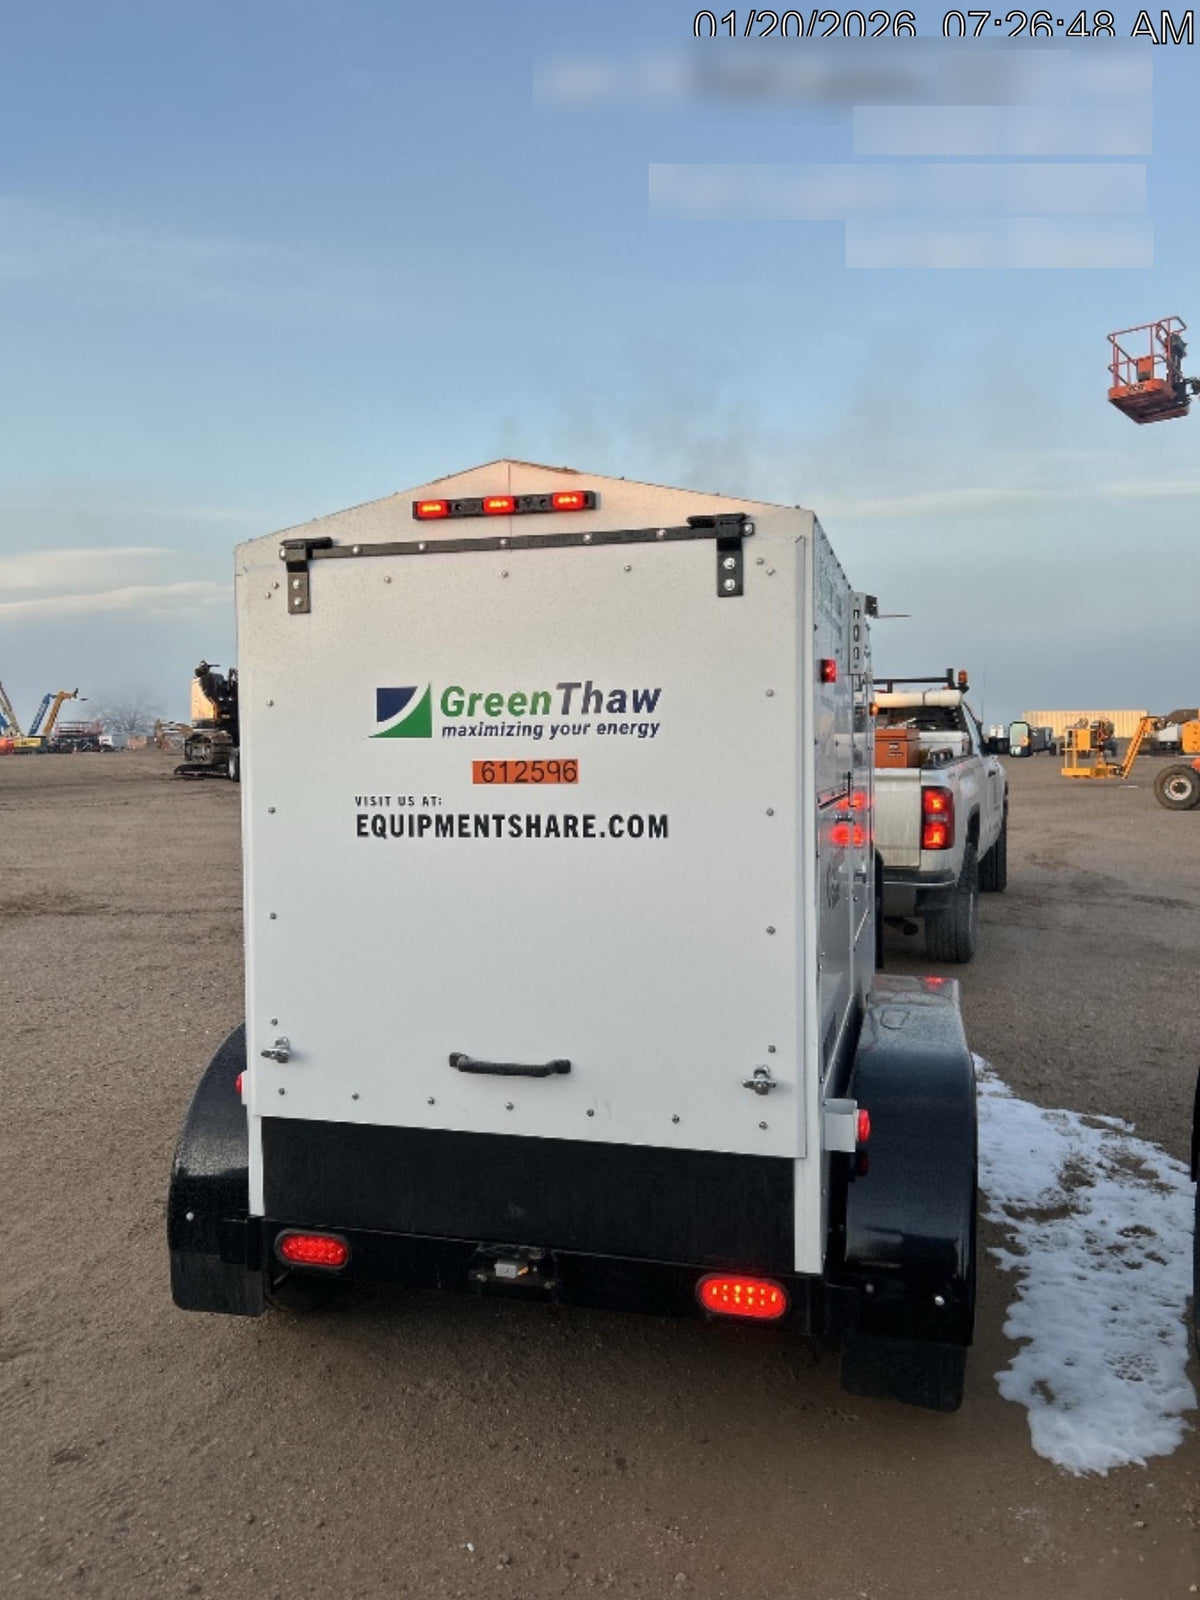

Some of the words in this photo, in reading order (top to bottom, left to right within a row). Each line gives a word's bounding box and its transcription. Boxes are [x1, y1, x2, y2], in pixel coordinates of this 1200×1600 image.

[441, 721, 543, 740] maximizing
[549, 722, 591, 740] your
[596, 721, 661, 739] energy
[481, 760, 578, 784] 612596
[354, 796, 392, 807] VISIT
[398, 796, 415, 807] US
[422, 796, 442, 807] AT:
[356, 813, 669, 839] EQUIPMENTSHARE.COM
